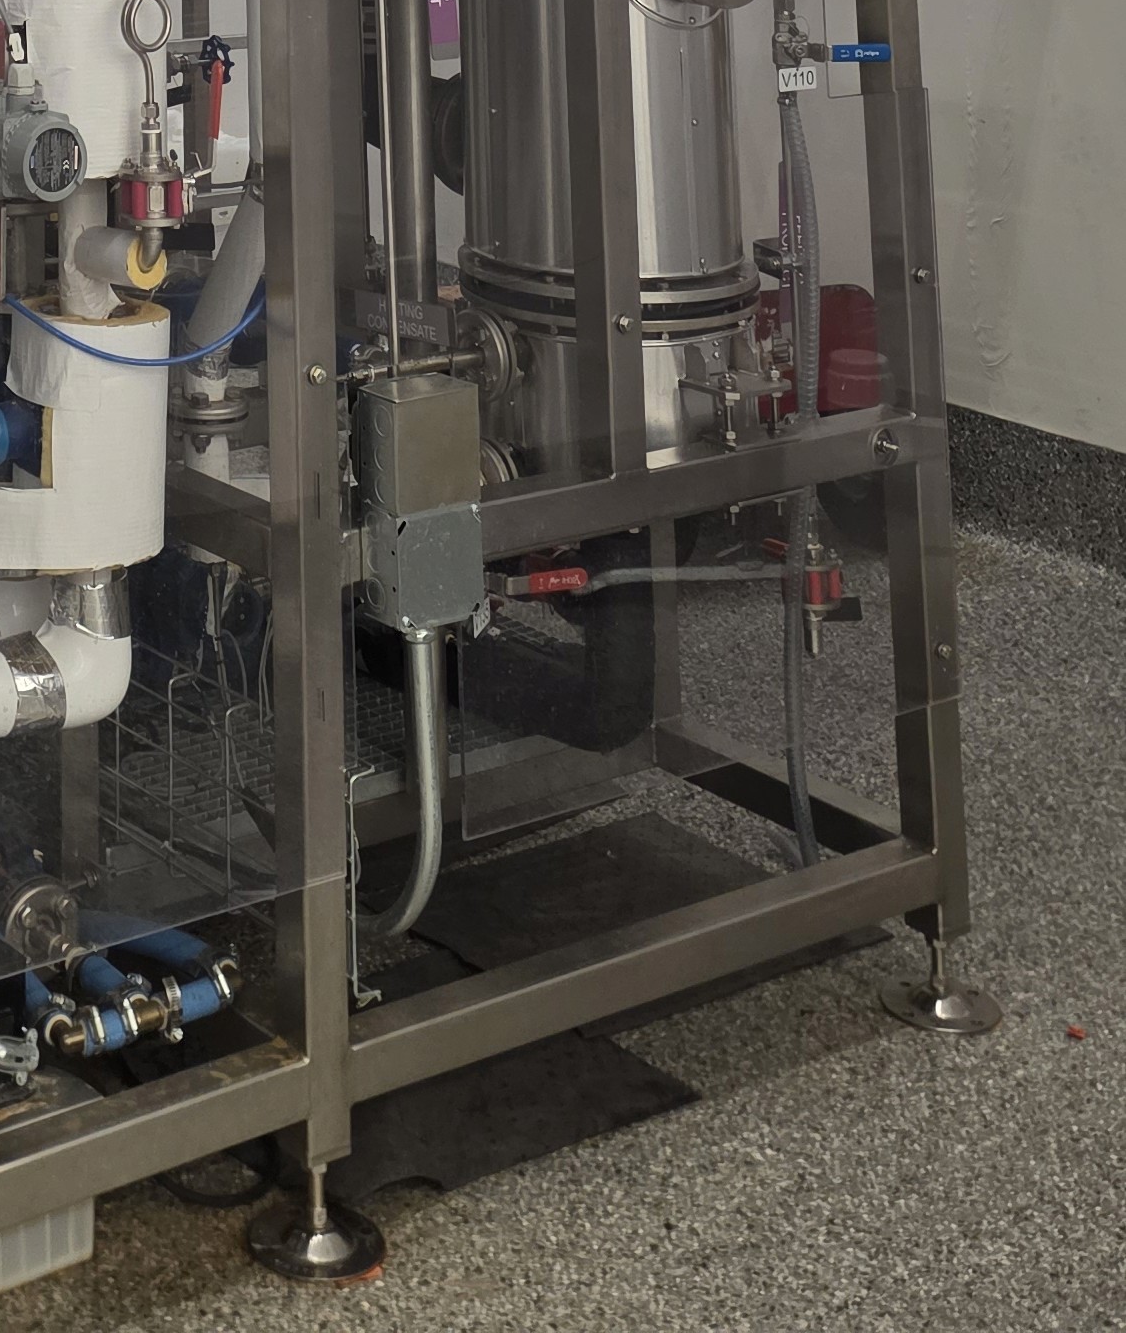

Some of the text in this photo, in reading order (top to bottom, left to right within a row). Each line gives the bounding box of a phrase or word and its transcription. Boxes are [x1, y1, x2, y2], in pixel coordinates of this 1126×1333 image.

[781, 70, 815, 88] V110
[378, 297, 424, 320] HTING
[367, 313, 437, 342] CONENSATE
